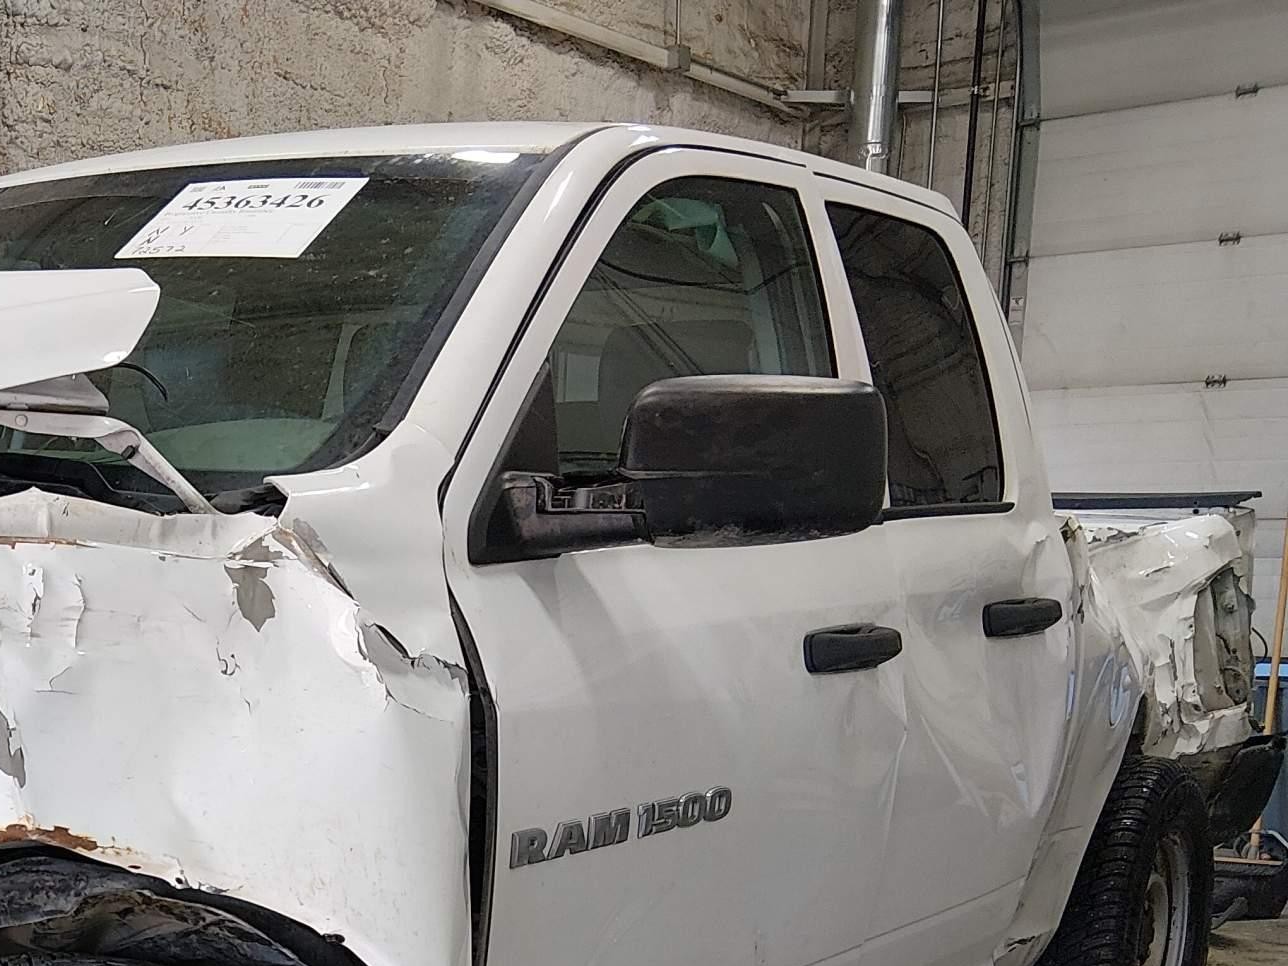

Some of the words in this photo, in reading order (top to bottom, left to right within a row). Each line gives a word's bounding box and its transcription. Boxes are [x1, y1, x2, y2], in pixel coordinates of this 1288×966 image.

[182, 194, 330, 211] 45363426
[510, 807, 631, 869] RAM
[637, 786, 732, 839] 1500
